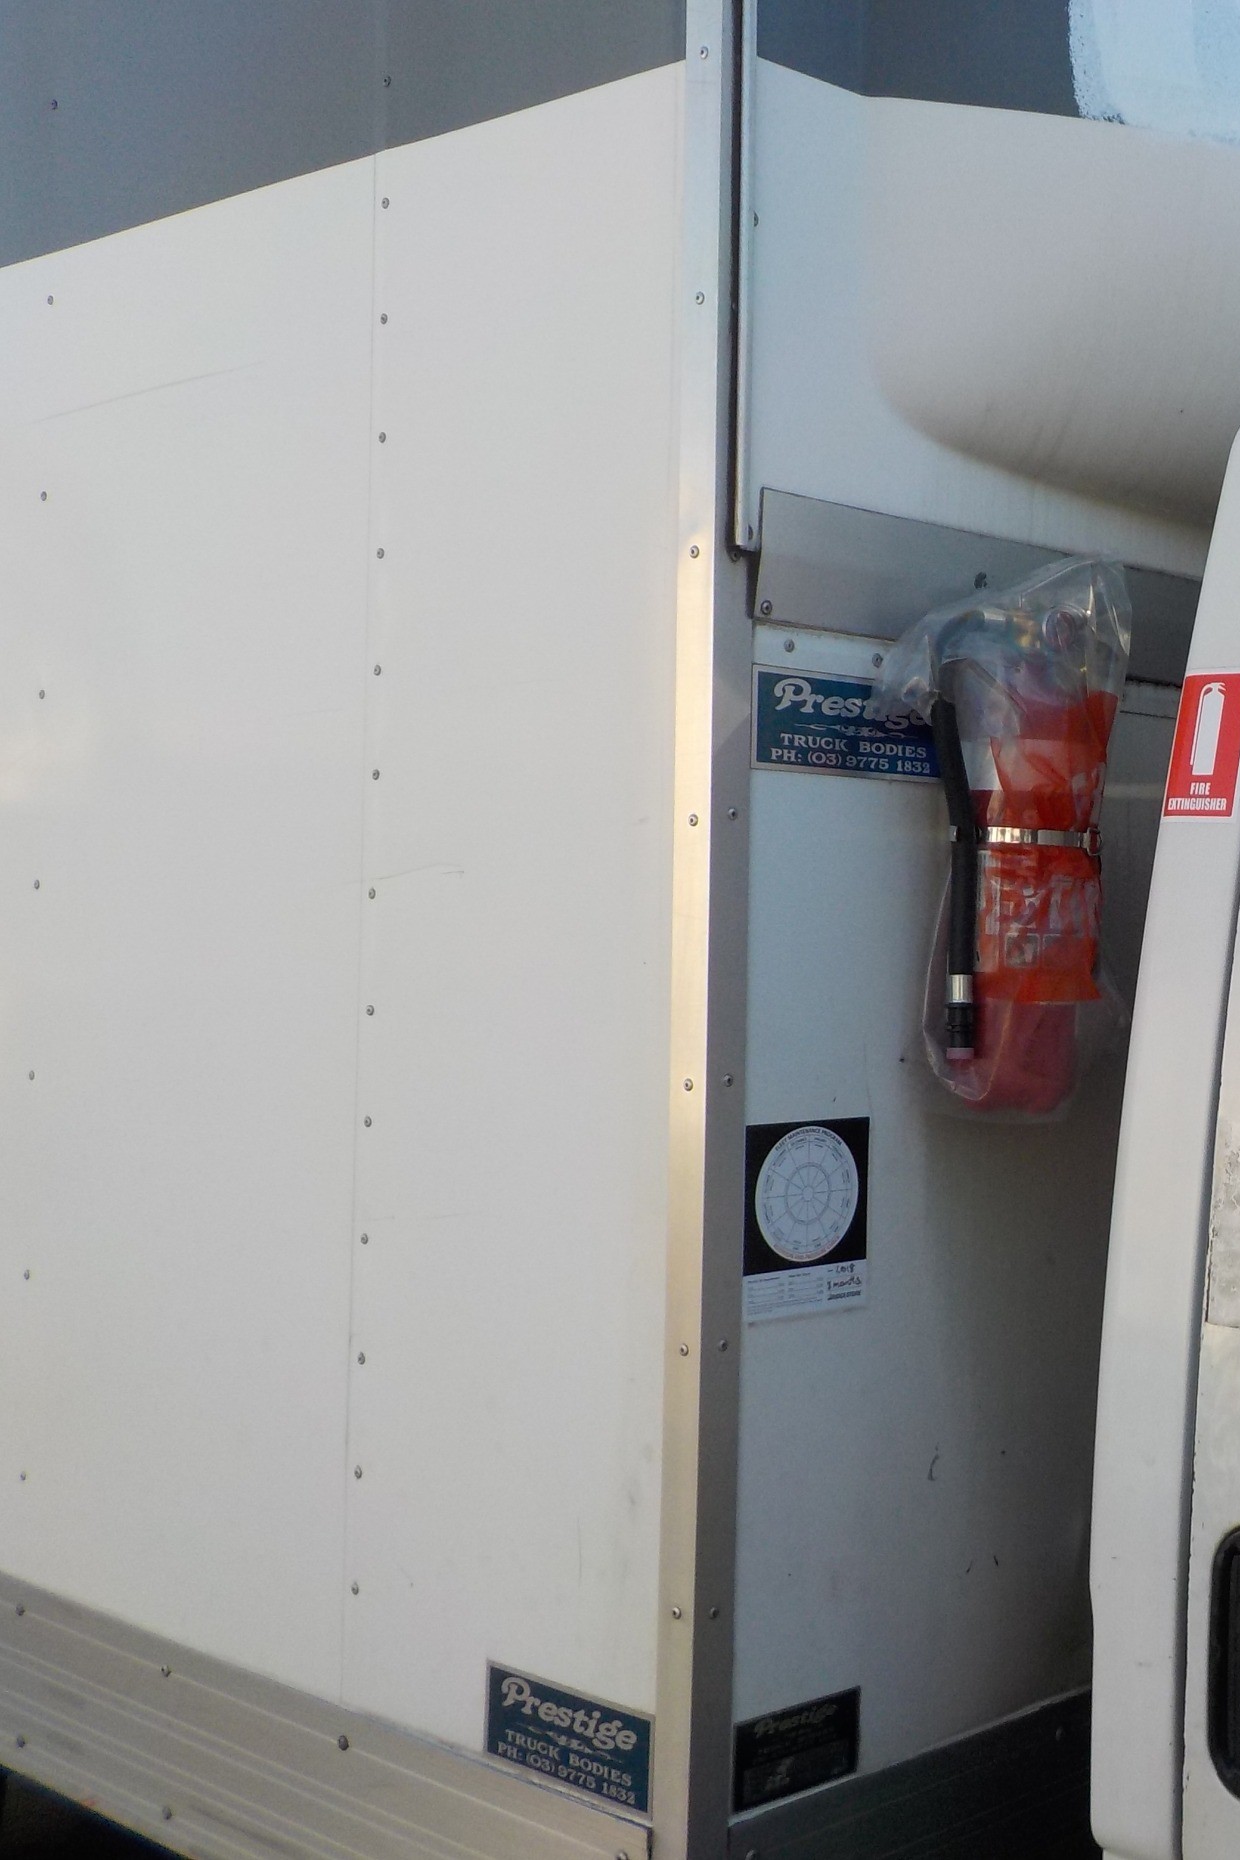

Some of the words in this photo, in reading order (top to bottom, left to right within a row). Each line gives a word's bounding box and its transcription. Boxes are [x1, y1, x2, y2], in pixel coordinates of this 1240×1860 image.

[780, 732, 849, 752] TRUCK
[859, 741, 927, 759] BODIES
[771, 747, 803, 763] PH:
[807, 750, 843, 767] (03)
[845, 754, 889, 771] 9775
[896, 759, 931, 775] 1832
[1189, 782, 1211, 795] FIRE
[1167, 797, 1228, 811] EXTINGUISHER
[821, 1128, 843, 1146] PROGRAM
[501, 1676, 638, 1750] Prestige
[505, 1728, 561, 1761] TRUCK
[569, 1752, 632, 1787] BODIES
[497, 1741, 523, 1761] PH:
[558, 1765, 597, 1789] 9775
[601, 1781, 636, 1805] 1832
